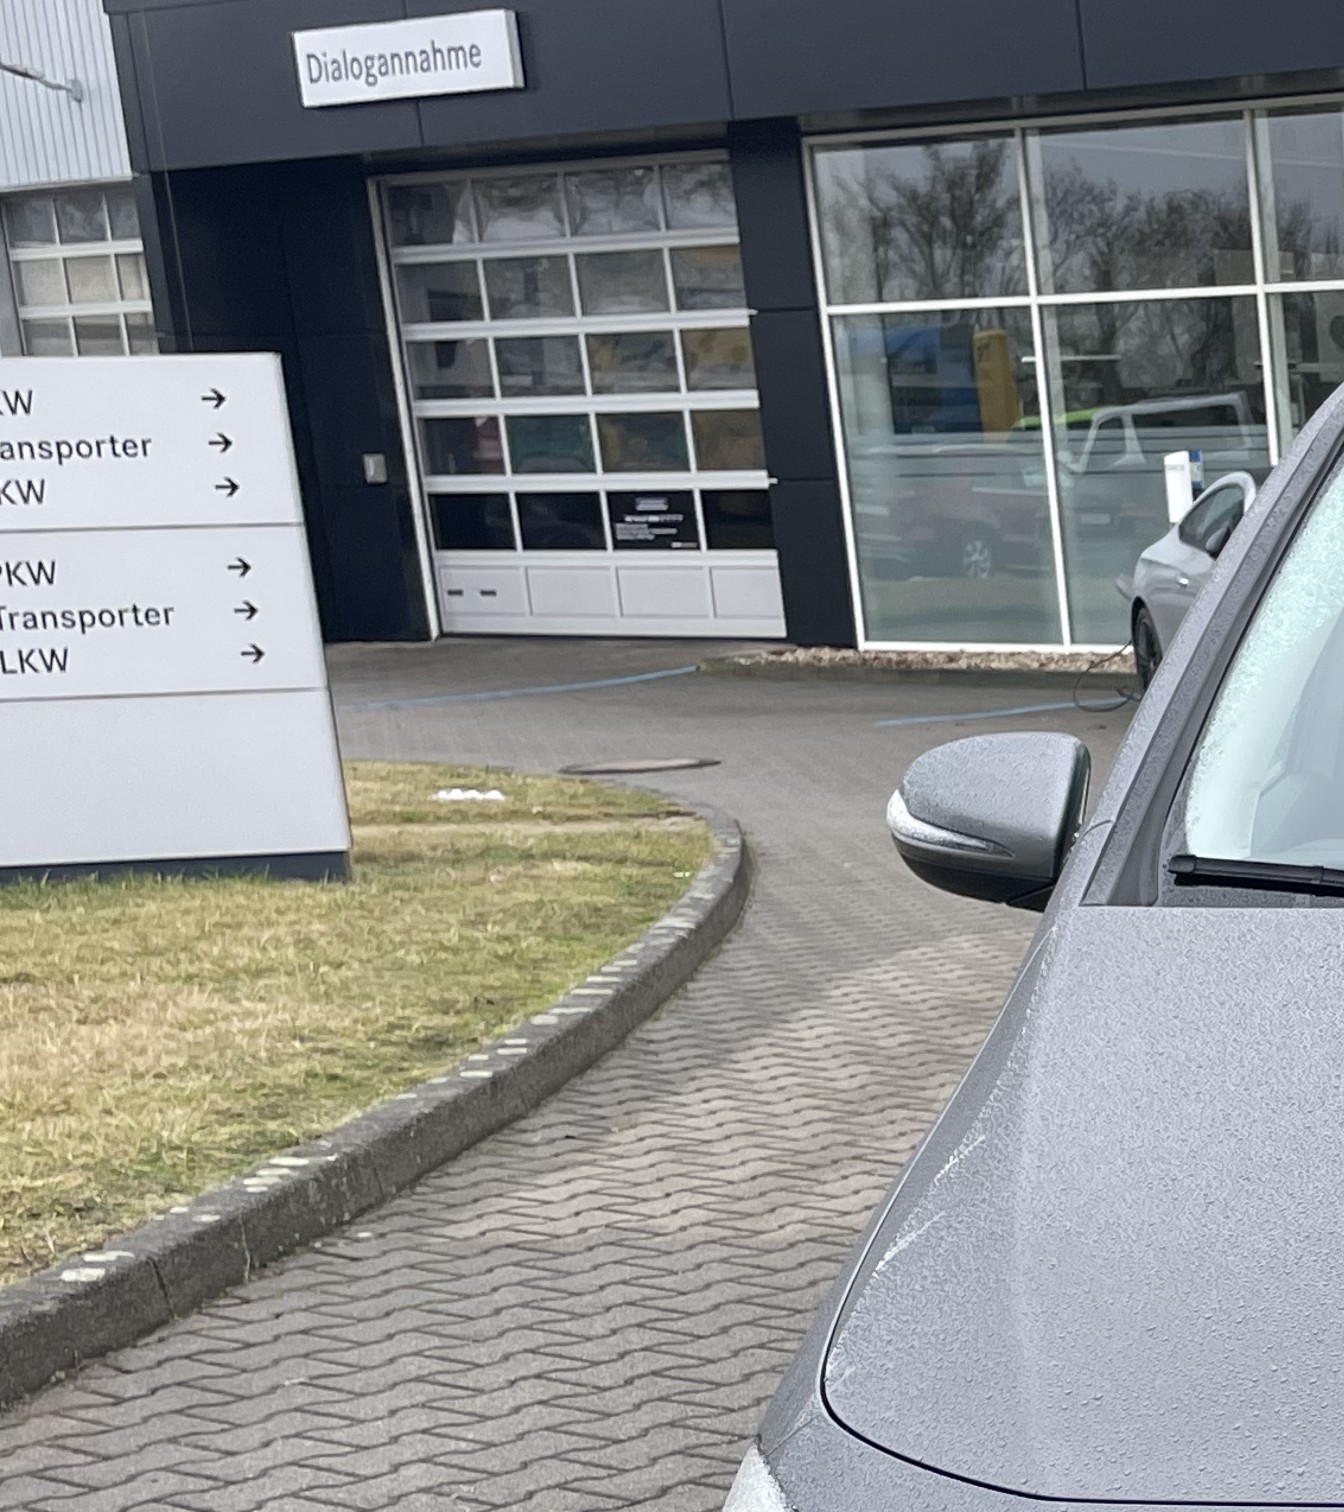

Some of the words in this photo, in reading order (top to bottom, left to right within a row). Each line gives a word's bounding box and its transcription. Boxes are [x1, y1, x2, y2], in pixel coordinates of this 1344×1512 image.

[306, 39, 482, 87] Dialogannahme
[0, 559, 56, 587] KW
[0, 646, 69, 675] LKW
